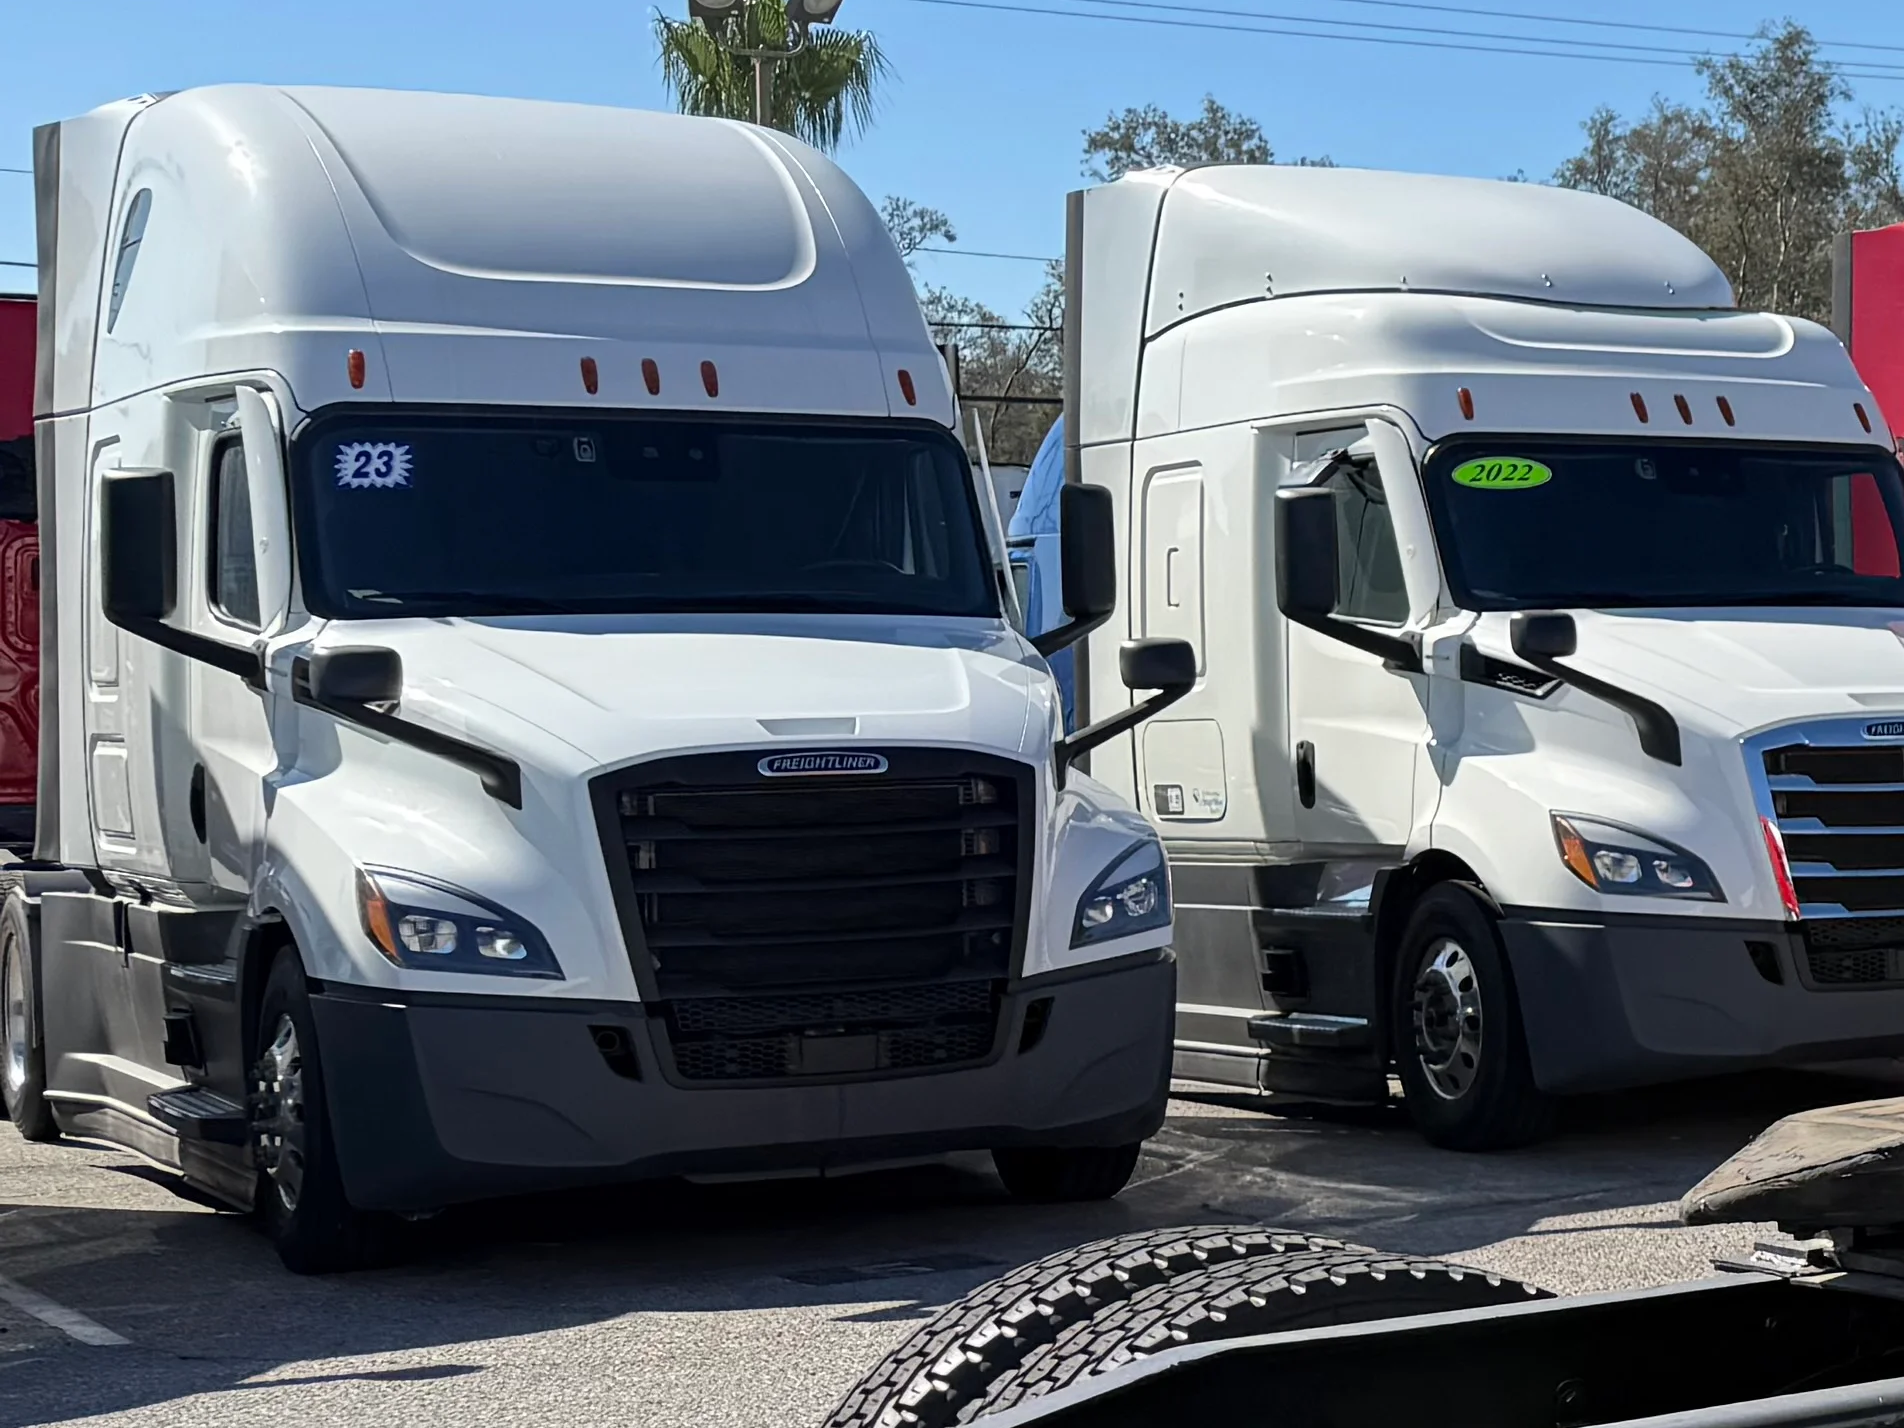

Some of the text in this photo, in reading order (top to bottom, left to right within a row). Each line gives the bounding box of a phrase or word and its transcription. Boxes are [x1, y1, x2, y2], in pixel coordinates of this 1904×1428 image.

[351, 450, 393, 479] 23
[1469, 462, 1533, 482] 2022
[773, 756, 876, 770] FREIGHTLINER
